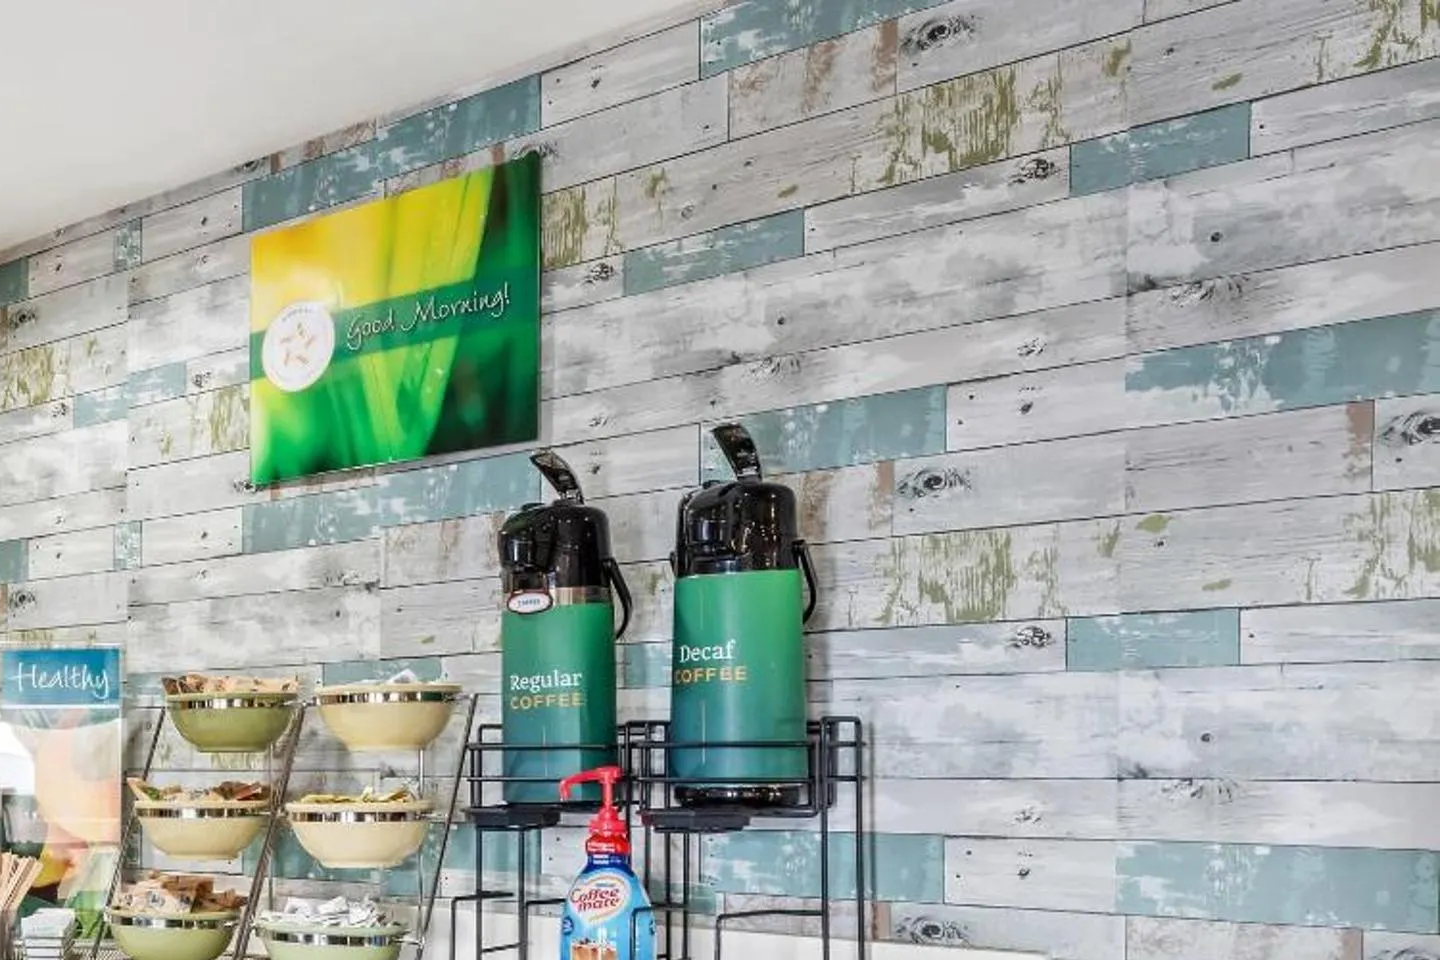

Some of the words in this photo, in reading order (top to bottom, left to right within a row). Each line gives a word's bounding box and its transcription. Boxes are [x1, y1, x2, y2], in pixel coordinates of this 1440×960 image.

[347, 309, 395, 350] Good
[400, 282, 510, 331] Morning!
[679, 638, 737, 663] Decaf
[8, 661, 111, 699] Healthy
[510, 669, 583, 694] Regular
[675, 666, 747, 685] COFFEE
[511, 692, 585, 710] COFFEE
[571, 888, 620, 903] Coffee
[577, 898, 620, 912] mate
